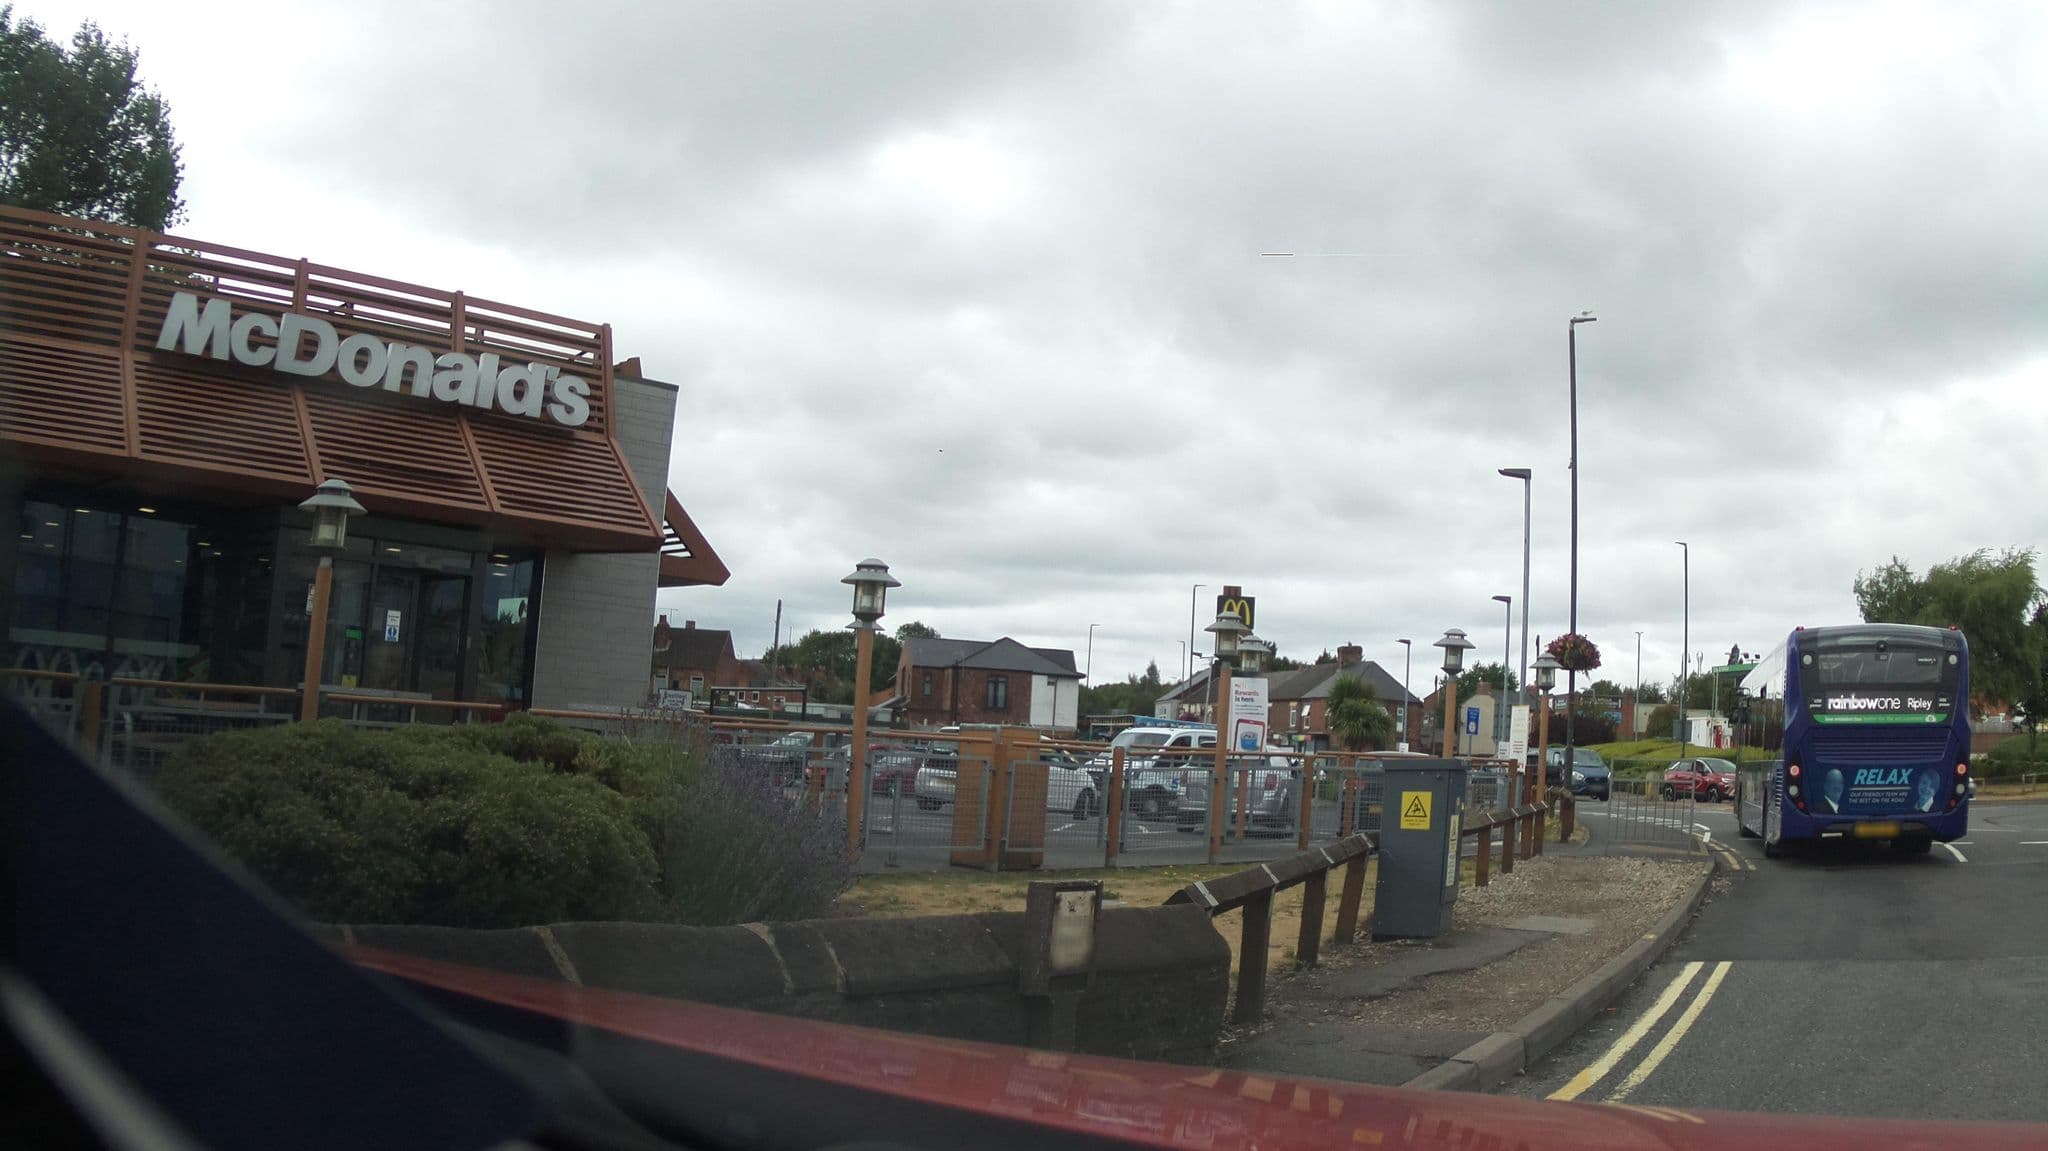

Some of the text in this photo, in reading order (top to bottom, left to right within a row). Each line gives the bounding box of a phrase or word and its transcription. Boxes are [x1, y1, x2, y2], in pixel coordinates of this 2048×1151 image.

[156, 292, 591, 428] McDonald's
[1907, 697, 1933, 711] Ripley
[1854, 768, 1913, 785] RELAX
